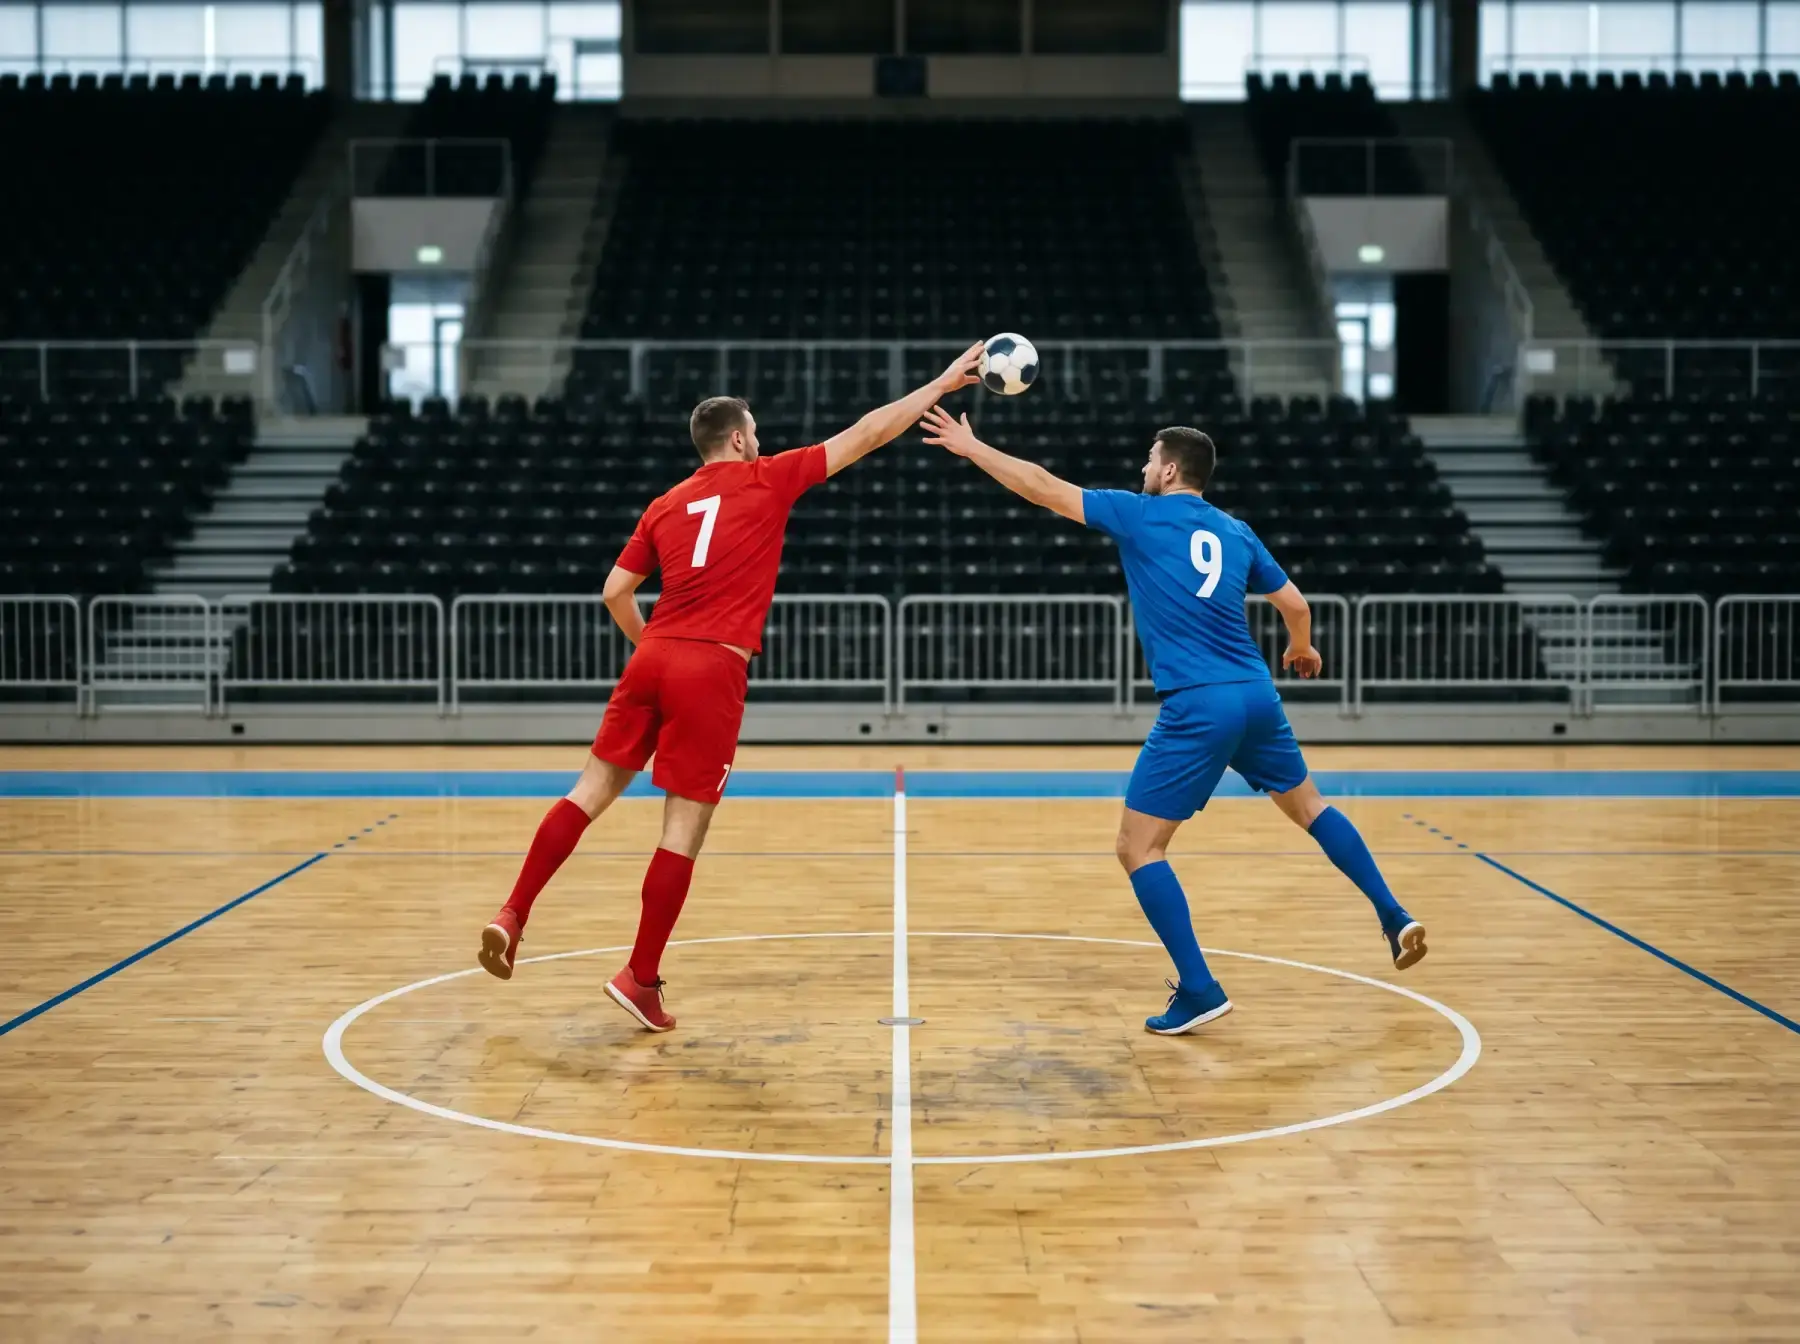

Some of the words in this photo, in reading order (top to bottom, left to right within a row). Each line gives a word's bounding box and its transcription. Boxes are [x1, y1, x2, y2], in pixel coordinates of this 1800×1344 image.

[686, 495, 721, 568] 7
[1190, 530, 1223, 598] 9
[716, 764, 731, 792] 7
